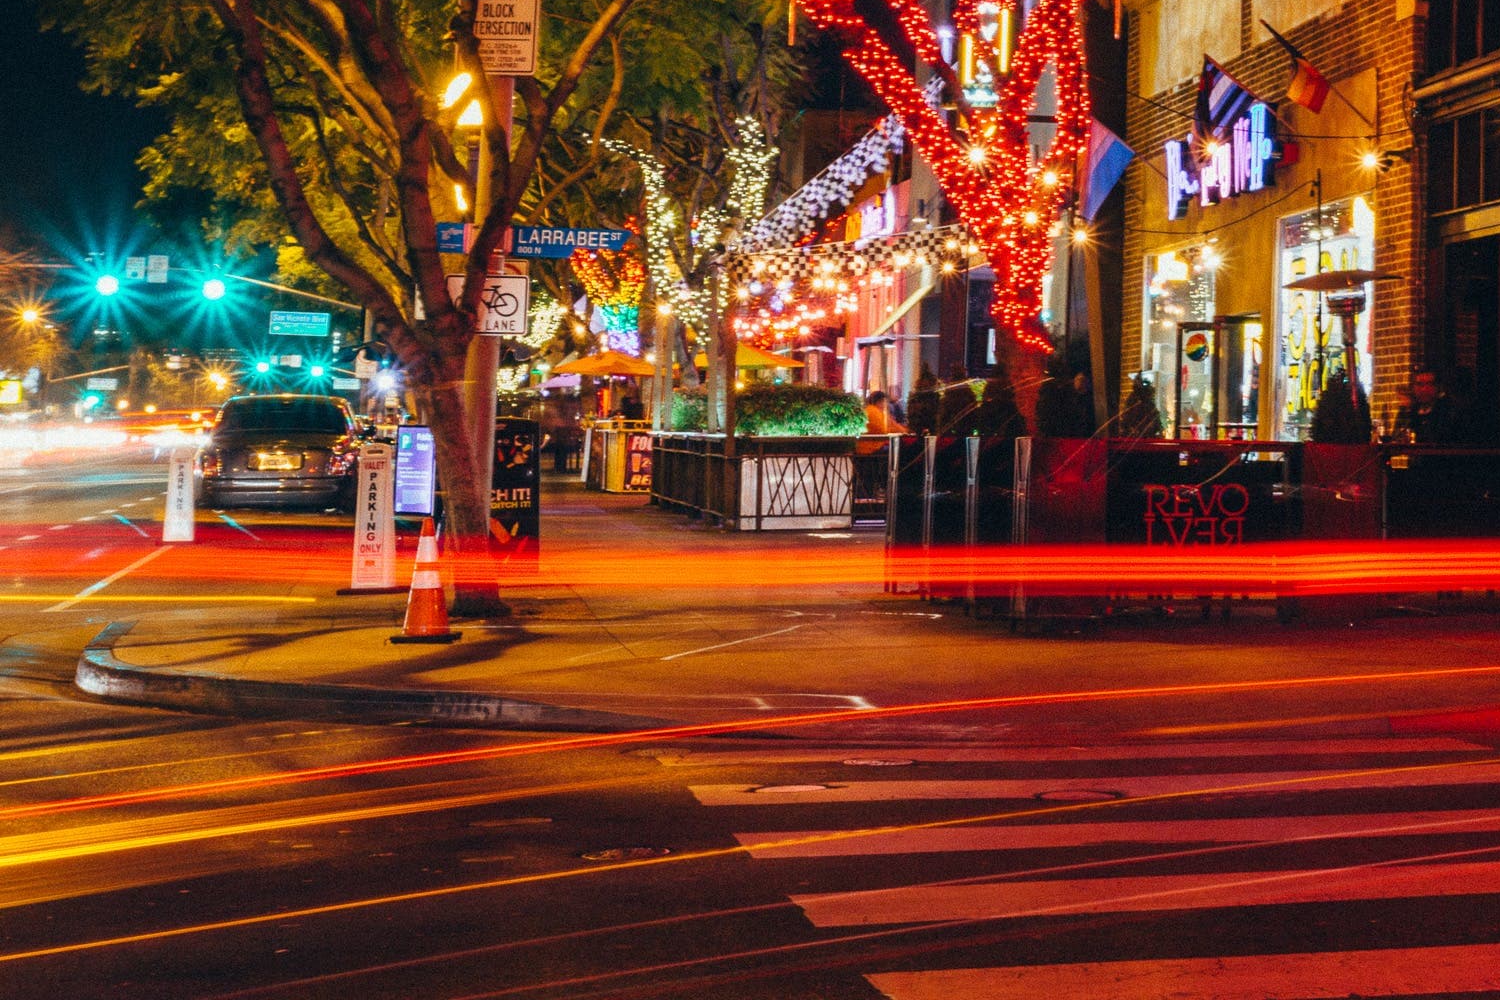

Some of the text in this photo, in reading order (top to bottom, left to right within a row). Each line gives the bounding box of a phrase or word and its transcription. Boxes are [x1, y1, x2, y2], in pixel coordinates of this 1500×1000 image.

[483, 3, 515, 18] BLOCK
[517, 229, 622, 247] LARRABEE ST
[485, 319, 516, 331] LANE
[364, 461, 385, 470] VALET
[512, 488, 531, 501] IT!
[1141, 483, 1249, 517] REVO
[366, 472, 378, 541] PARKING
[360, 543, 382, 554] ONLY
